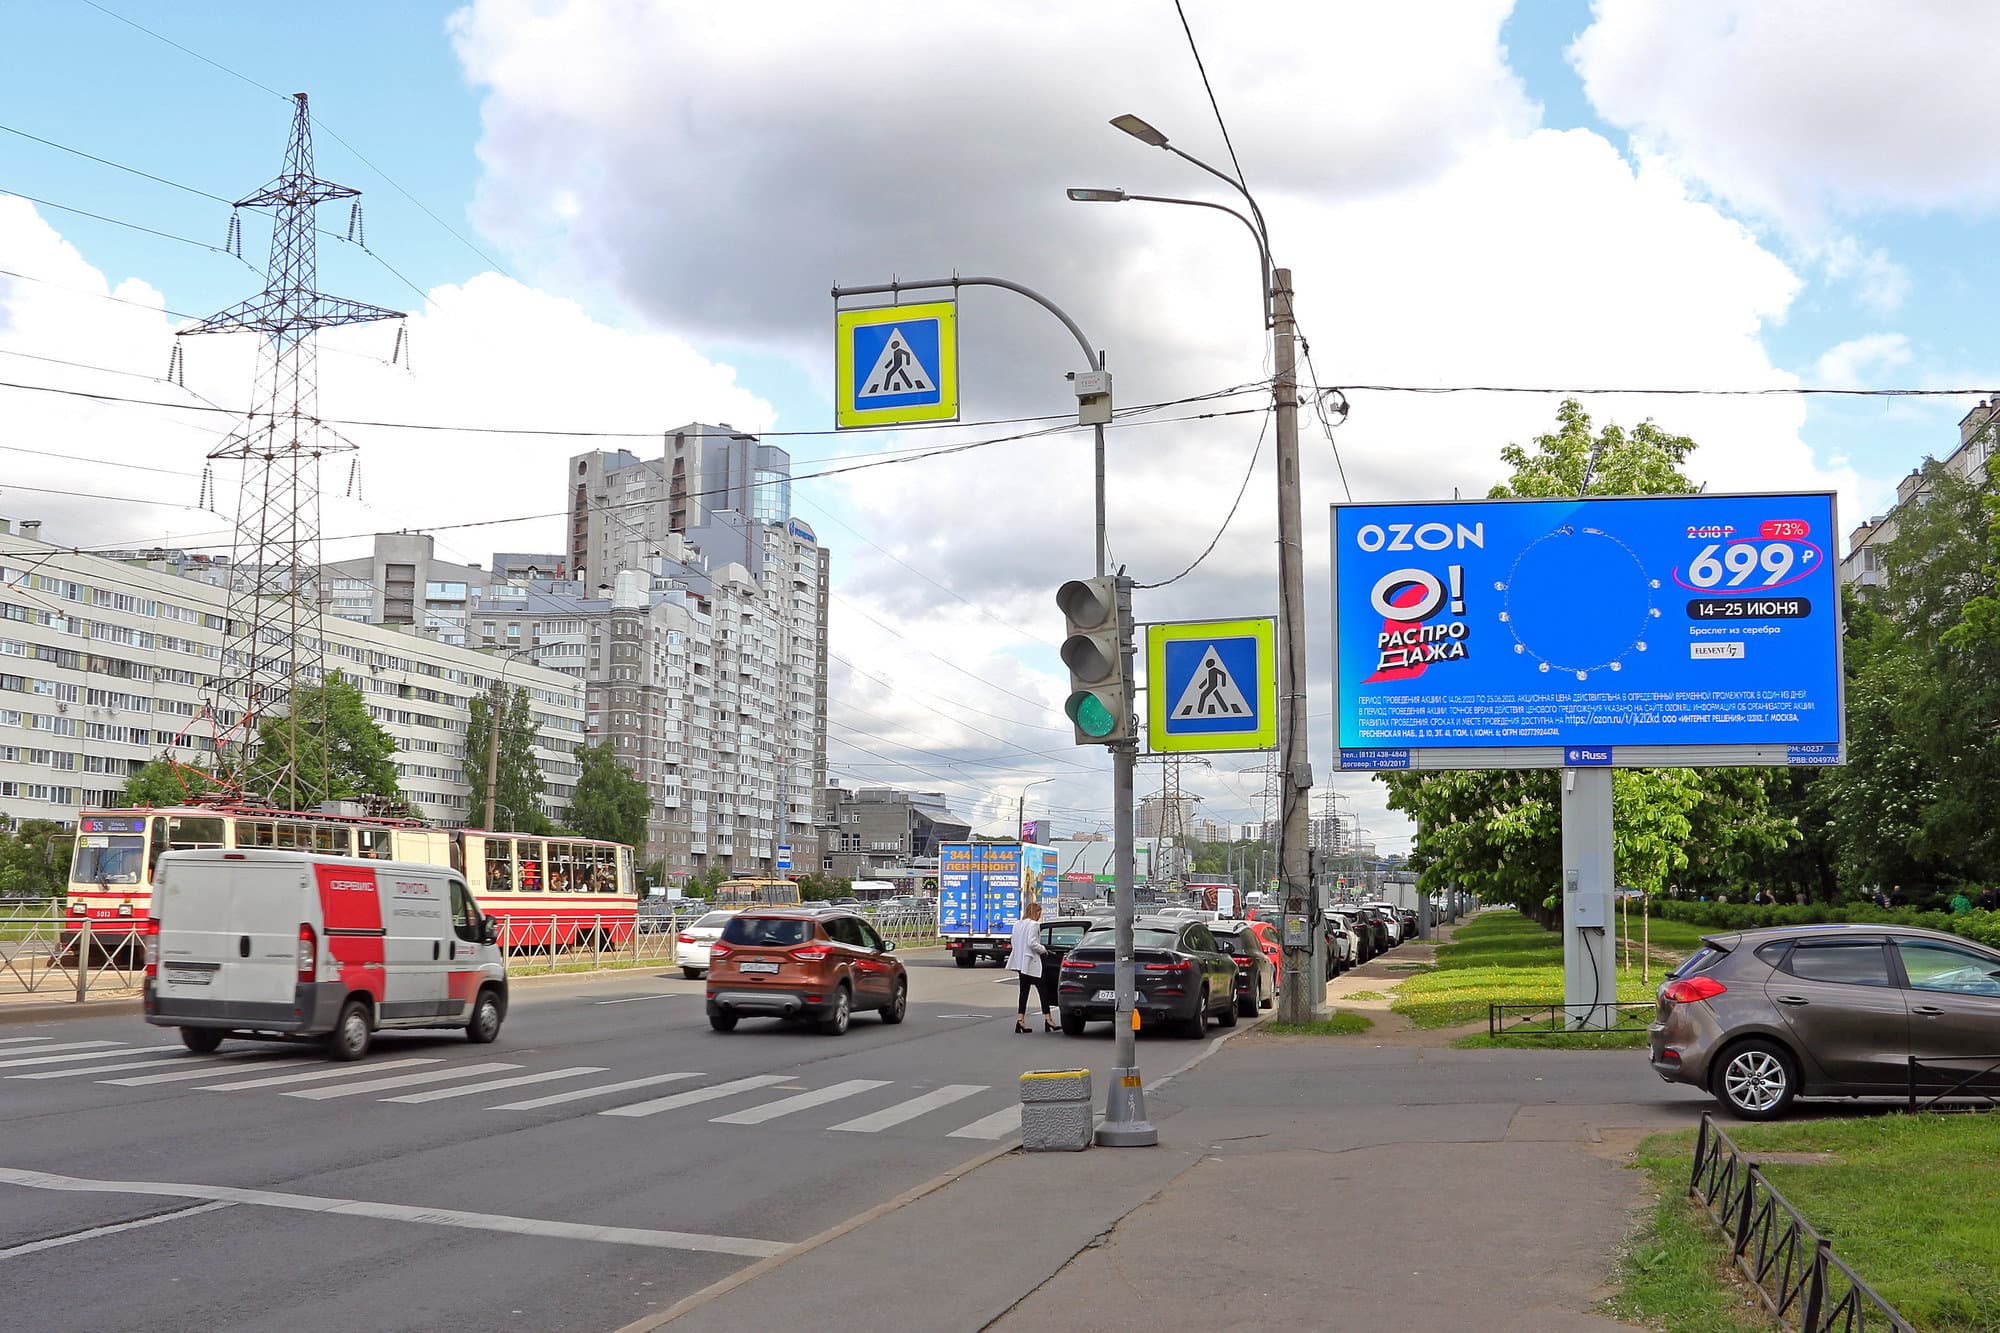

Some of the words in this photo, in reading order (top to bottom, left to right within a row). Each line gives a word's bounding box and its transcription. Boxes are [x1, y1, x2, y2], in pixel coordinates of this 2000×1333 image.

[1357, 522, 1484, 552] OZON
[1688, 543, 1794, 587] 699
[1747, 601, 1799, 616] ИЮНЯ
[1378, 621, 1469, 649] РАСПРО
[1689, 626, 1727, 636] Браслет
[1742, 625, 1781, 635] серебра
[1377, 641, 1467, 671] ДАЖА
[1502, 728, 1518, 736] ОГРН
[1581, 750, 1608, 760] Russ
[1801, 745, 1824, 753] 40237
[93, 821, 103, 831] 55
[330, 879, 375, 891] СЕРВИС
